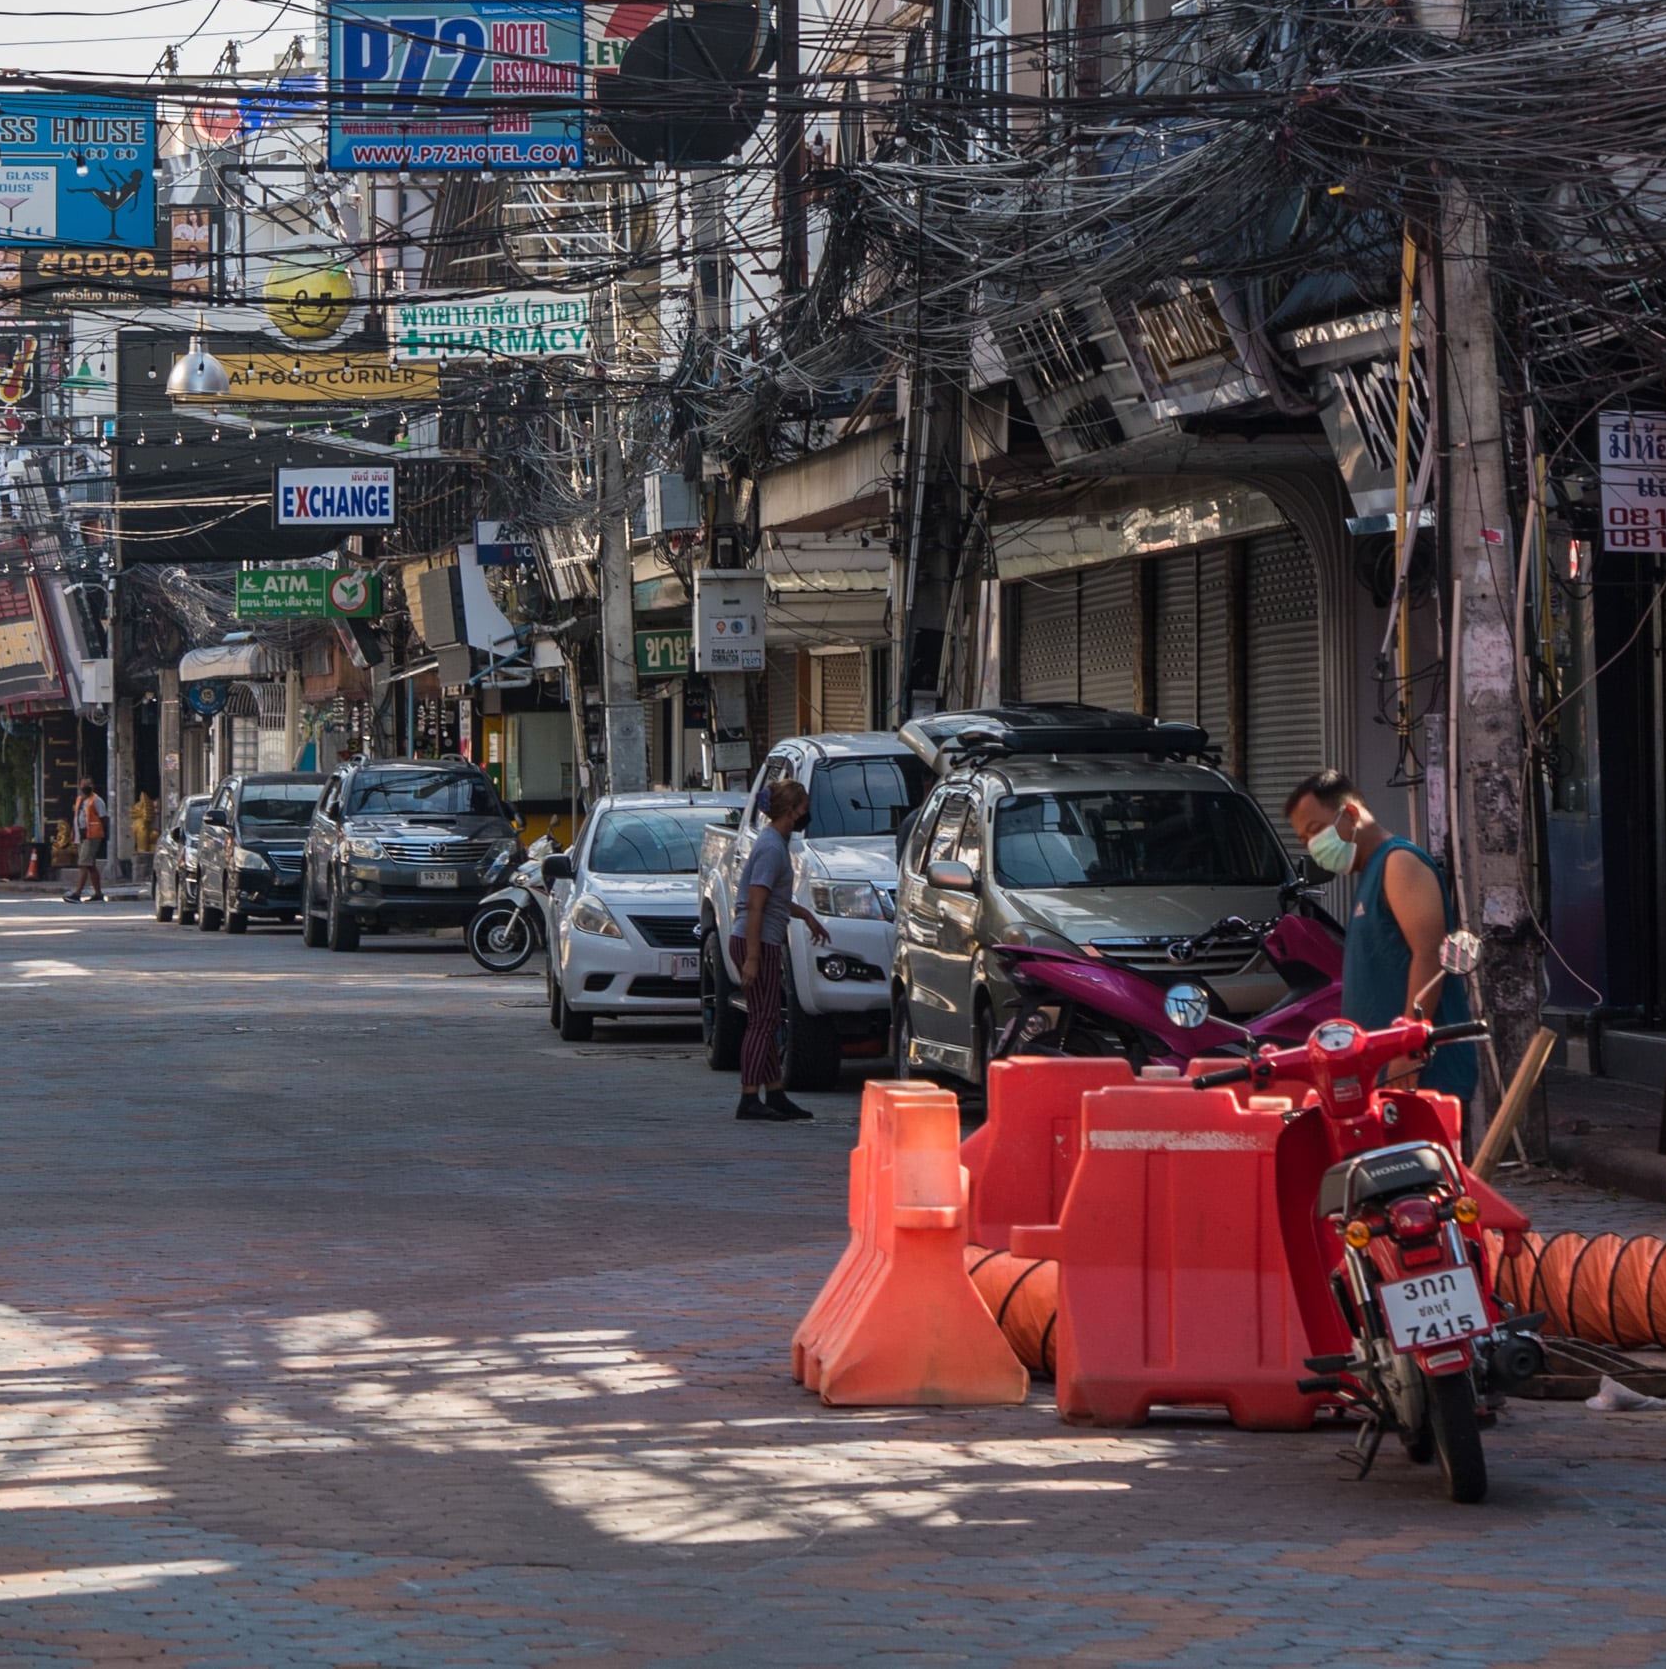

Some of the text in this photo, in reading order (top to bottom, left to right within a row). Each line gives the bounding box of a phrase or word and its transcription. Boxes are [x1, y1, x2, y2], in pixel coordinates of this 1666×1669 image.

[340, 14, 549, 120] P72 HOTEL
[51, 116, 147, 146] HOUSE
[352, 144, 577, 165] WWW.P72HOTEL.COM
[5, 171, 50, 181] GLASS
[429, 327, 588, 355] PHARMACY
[258, 370, 318, 385] FOOD
[326, 369, 416, 385] CORNER
[283, 485, 390, 518] EXCHANGE
[263, 576, 309, 593] ATM
[1370, 1159, 1421, 1180] HONDA
[1405, 1313, 1476, 1346] 7415
